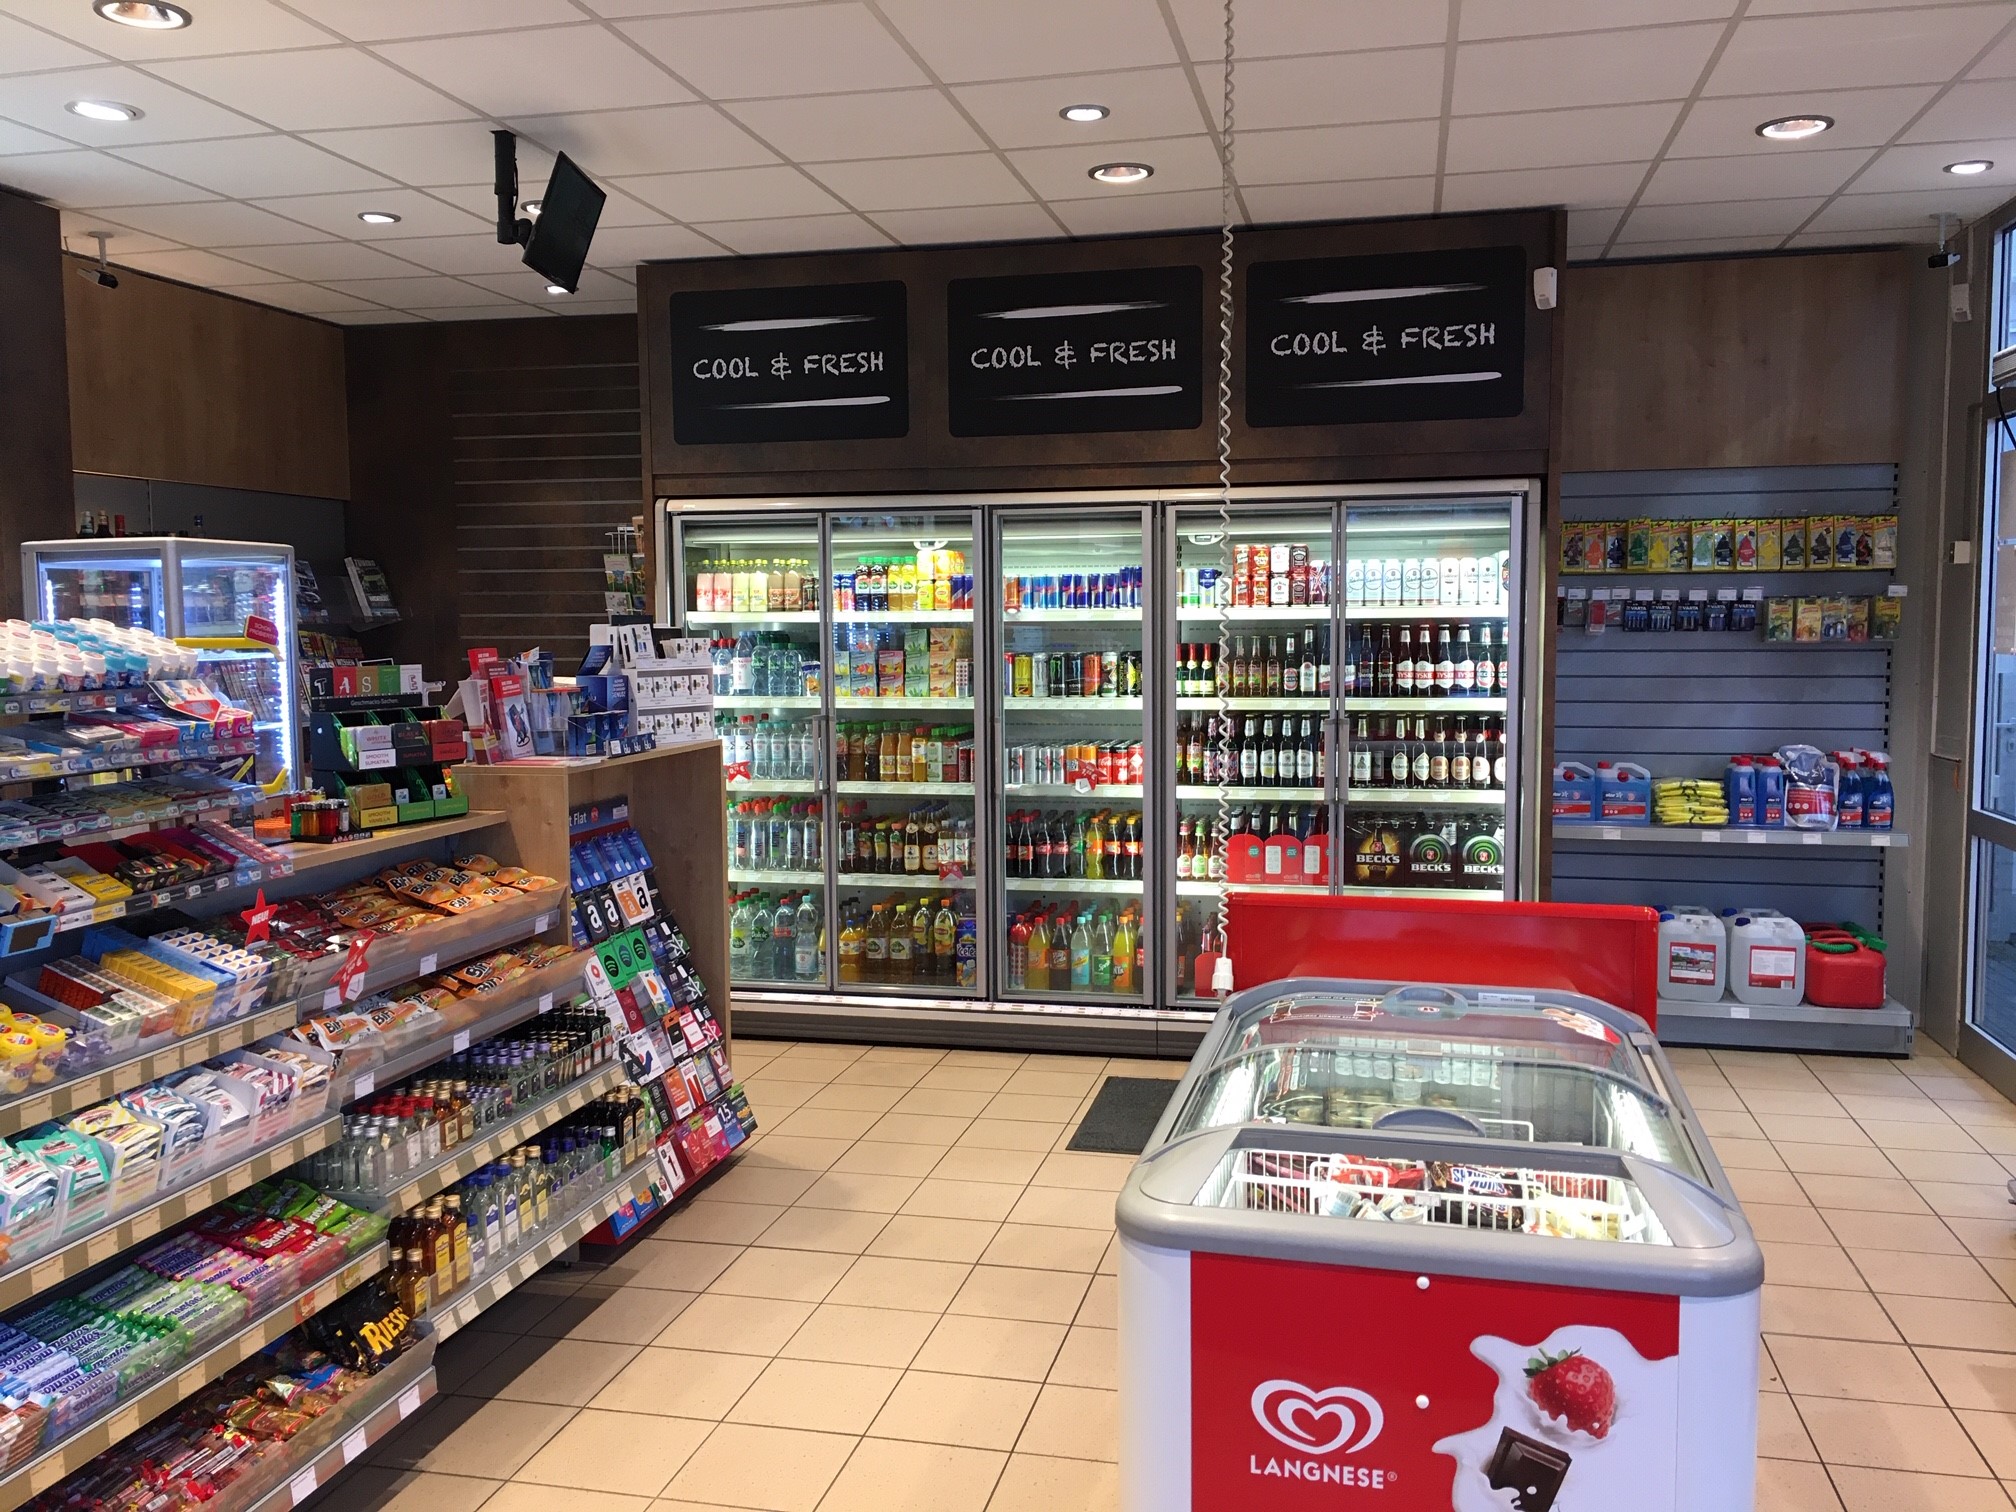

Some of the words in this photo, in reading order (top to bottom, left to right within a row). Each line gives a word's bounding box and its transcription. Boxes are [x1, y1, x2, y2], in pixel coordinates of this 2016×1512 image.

[1270, 330, 1348, 357] COOL
[1361, 324, 1387, 356] &
[1400, 322, 1496, 350] FRESH
[970, 345, 1042, 370] COOL
[1054, 340, 1077, 370] &
[1089, 338, 1177, 365] FRESH
[692, 356, 759, 380] COOL
[770, 351, 792, 381] &
[803, 351, 885, 376] FRESH
[633, 740, 642, 753] blu
[644, 737, 652, 751] blu
[367, 811, 391, 819] SMOOTH
[573, 812, 588, 826] Flat
[1356, 853, 1401, 864] BECK'S
[1411, 862, 1452, 873] BECK'S
[636, 886, 649, 910] a
[251, 910, 269, 926] NEU!
[587, 905, 603, 930] a
[604, 899, 619, 923] a
[324, 1020, 345, 1034] BiFi
[371, 1010, 395, 1026] BiFi
[237, 1263, 269, 1285] mentos
[0, 1342, 42, 1370] mentos
[10, 1347, 53, 1375] mentos
[93, 1342, 132, 1370] mentos
[60, 1367, 103, 1396] mentos
